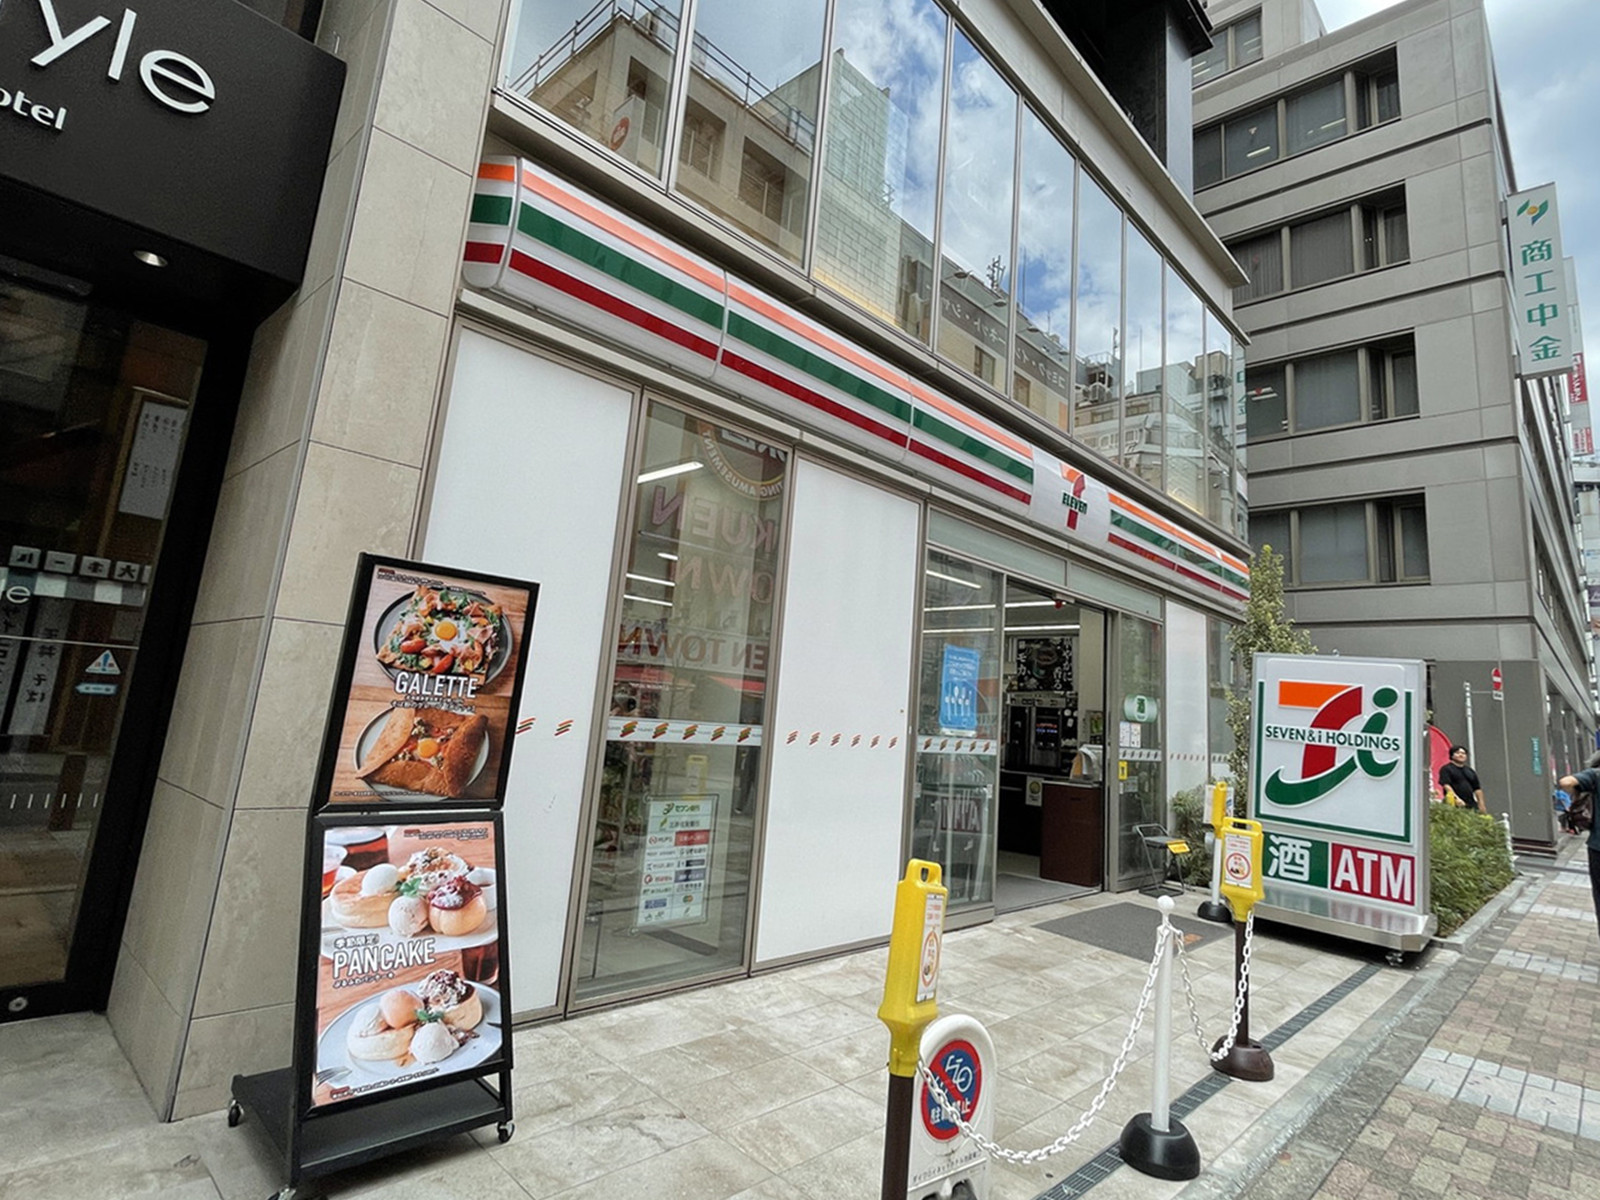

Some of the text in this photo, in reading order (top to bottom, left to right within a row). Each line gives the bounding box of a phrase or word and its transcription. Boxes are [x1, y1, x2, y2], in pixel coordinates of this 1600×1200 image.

[1520, 237, 1562, 363] 商工中金
[1061, 492, 1088, 515] ELEVEN
[394, 671, 479, 699] GALETTE
[1325, 728, 1401, 751] HOLDINGS
[1268, 834, 1312, 883] 酒
[1334, 848, 1413, 903] ATM
[333, 937, 436, 979] PANCAKE
